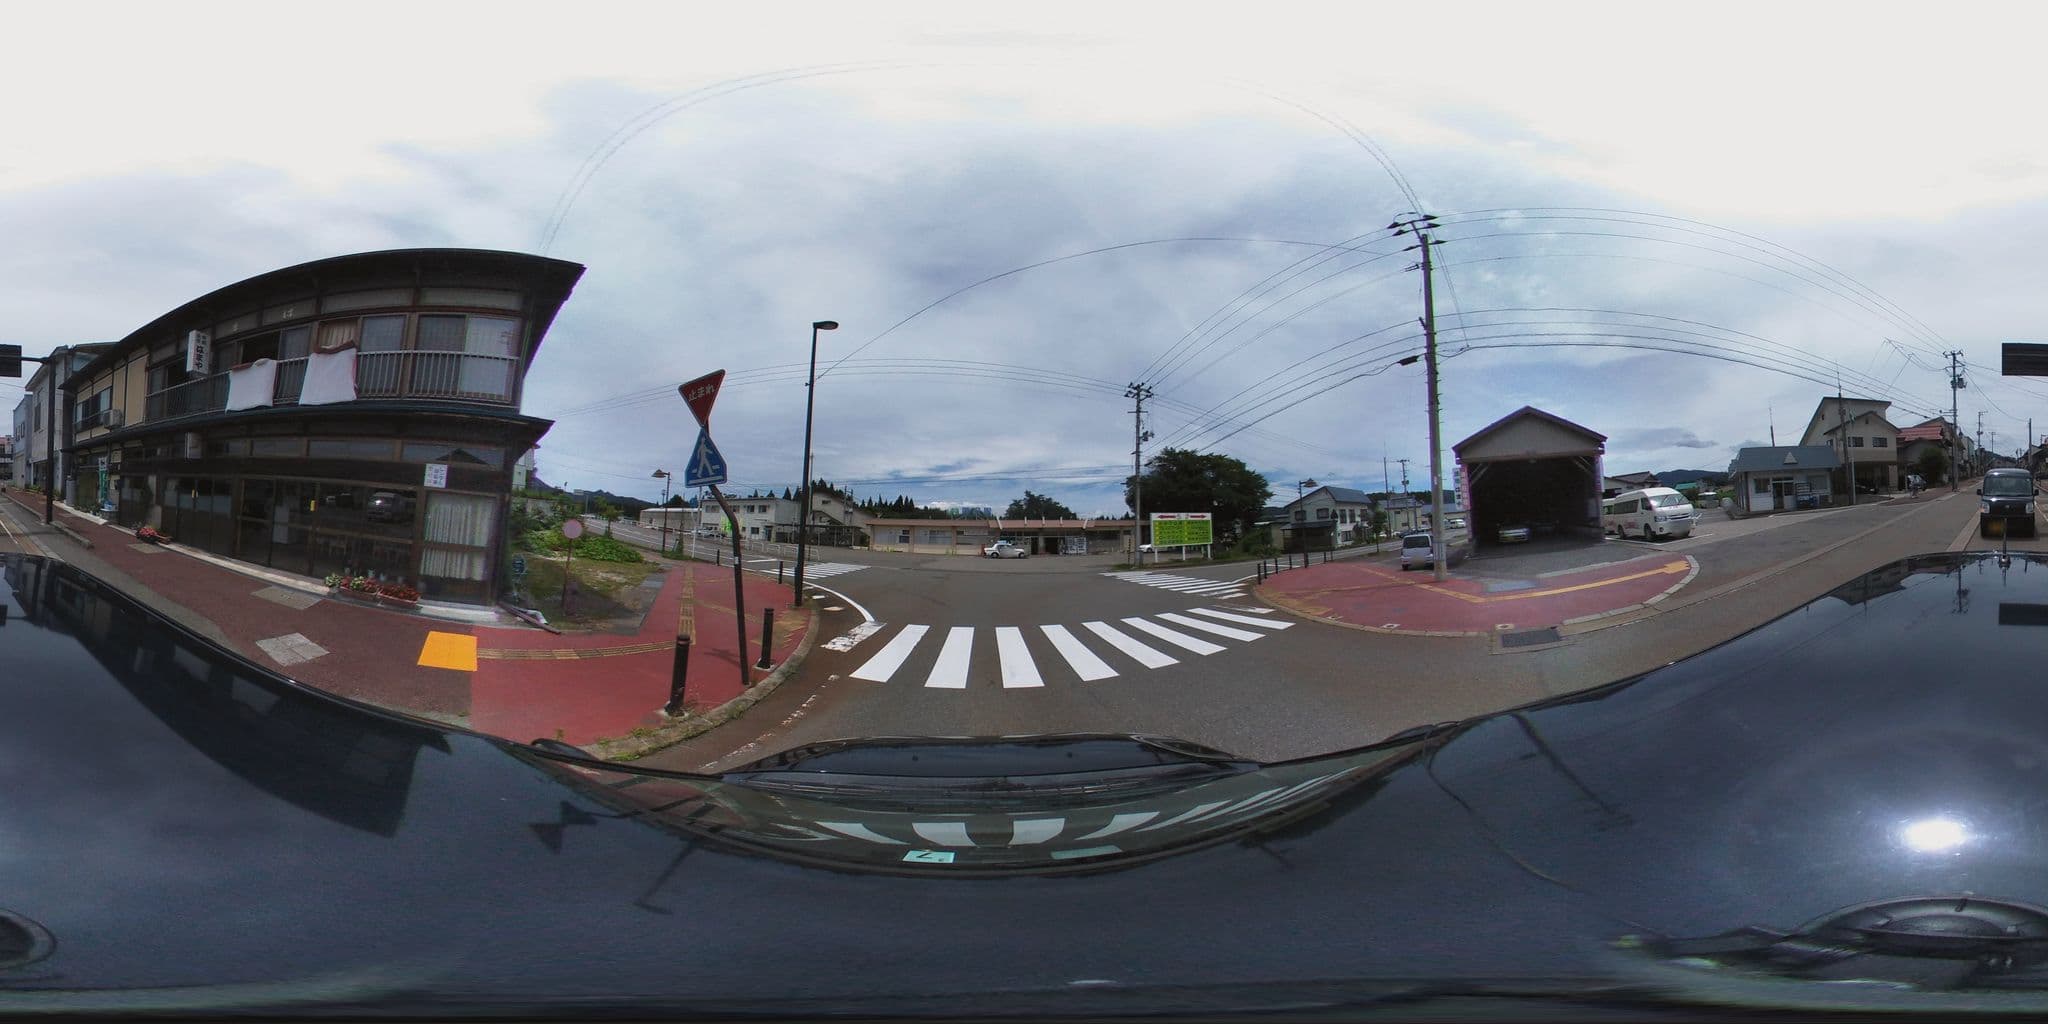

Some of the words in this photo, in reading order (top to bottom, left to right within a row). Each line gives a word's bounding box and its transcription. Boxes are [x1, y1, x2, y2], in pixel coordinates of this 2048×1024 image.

[194, 345, 204, 370] はまや
[688, 383, 715, 402] 止まれ
